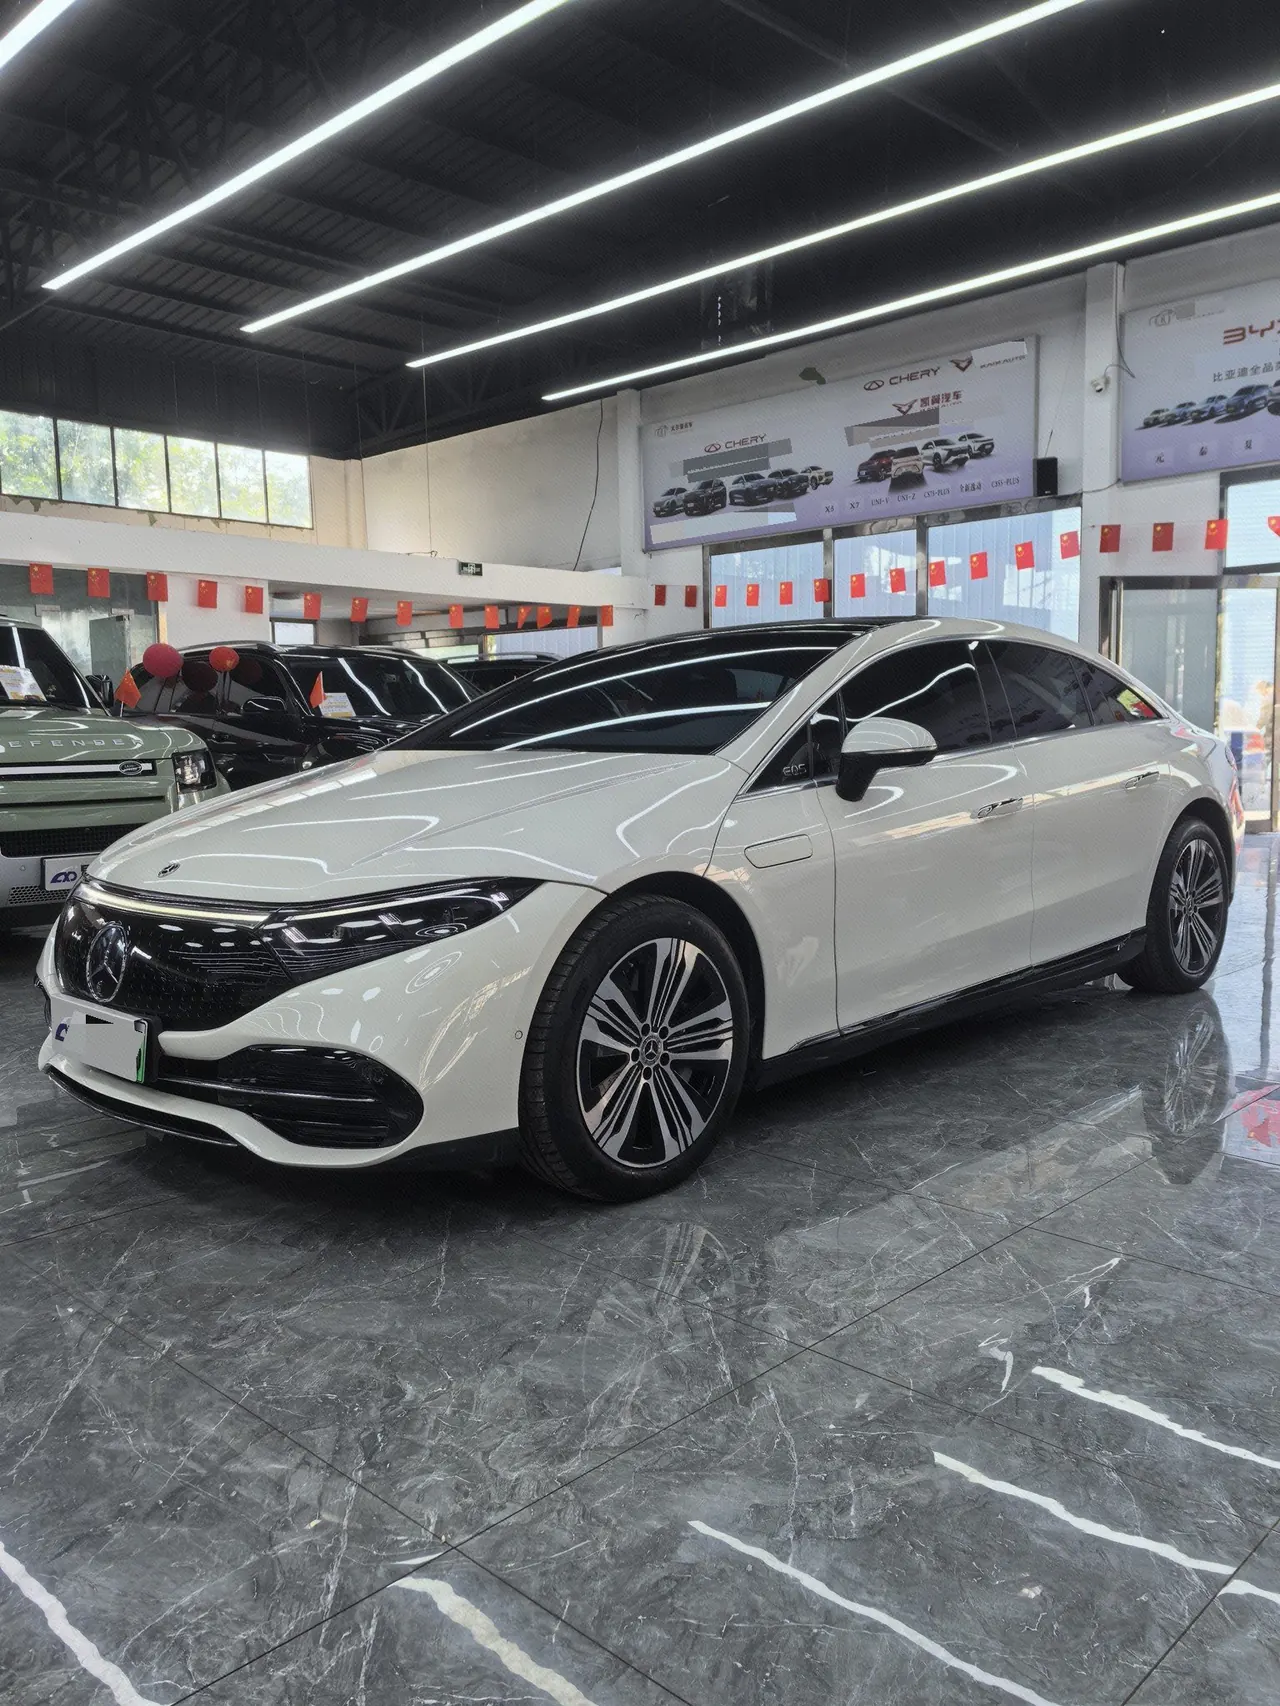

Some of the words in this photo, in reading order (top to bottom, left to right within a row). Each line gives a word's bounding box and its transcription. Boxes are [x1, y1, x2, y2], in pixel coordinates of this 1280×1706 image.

[1223, 319, 1280, 345] BY
[889, 367, 941, 386] CHERY
[919, 390, 962, 408] 凯翼汽车
[725, 433, 767, 449] CHERY
[849, 501, 860, 510] X7
[783, 763, 807, 776] EQS
